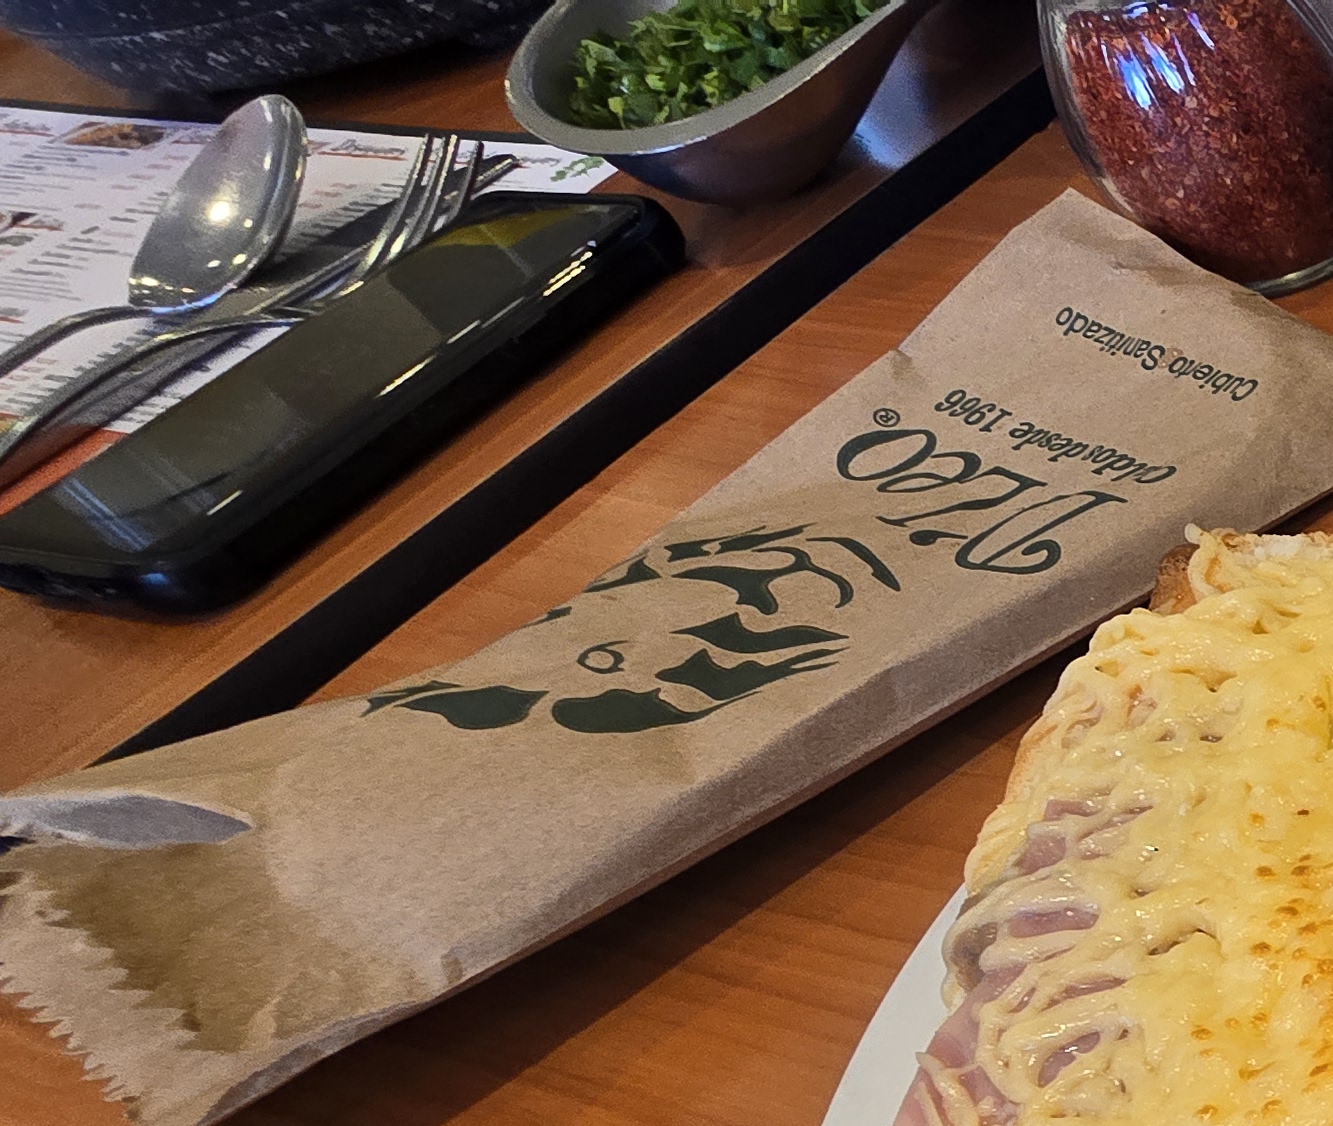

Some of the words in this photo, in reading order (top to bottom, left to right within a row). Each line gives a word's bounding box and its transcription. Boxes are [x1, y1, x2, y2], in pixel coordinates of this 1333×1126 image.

[1055, 305, 1166, 371] Sanitizado
[1168, 355, 1260, 402] Cubierto
[934, 388, 1013, 434] 1966
